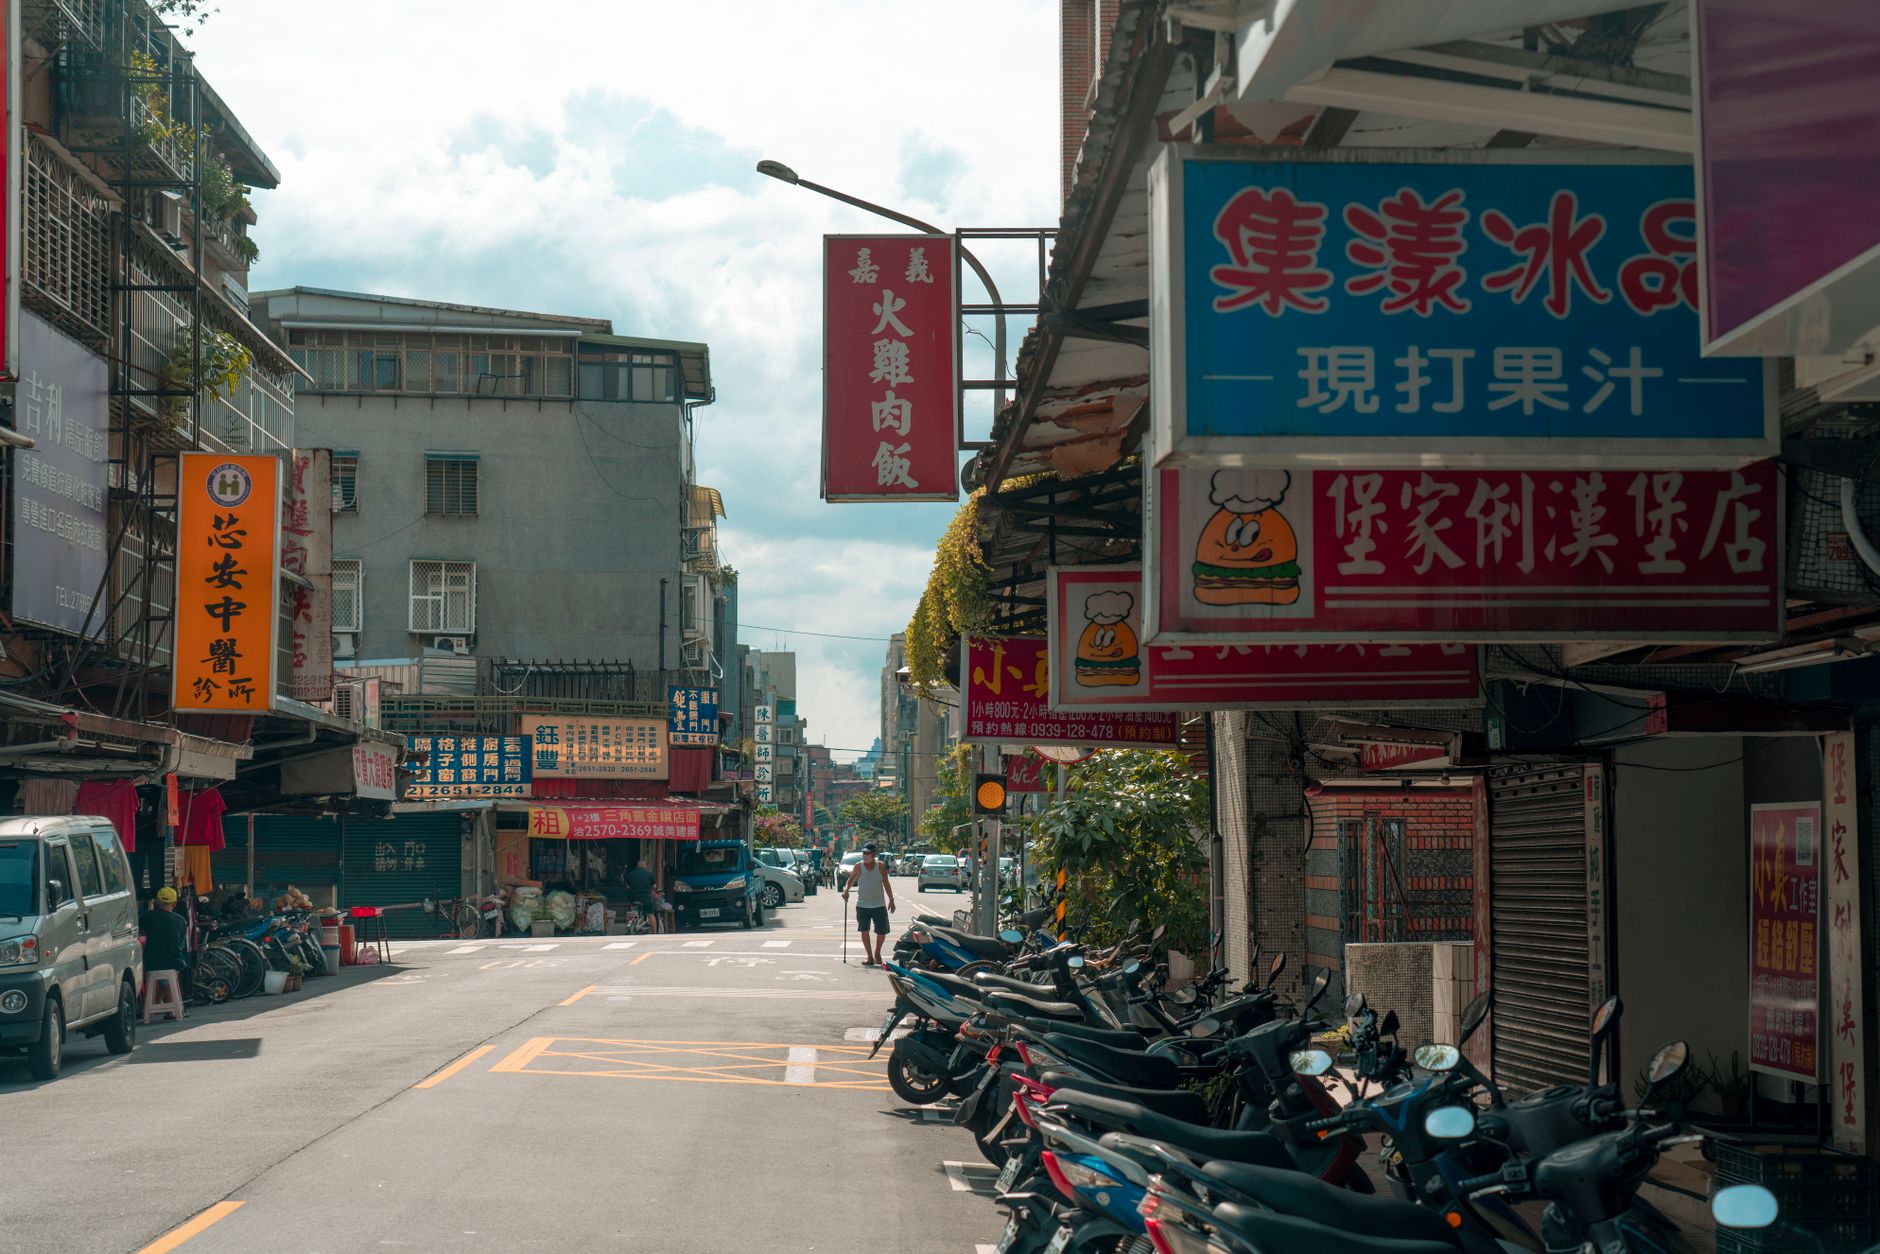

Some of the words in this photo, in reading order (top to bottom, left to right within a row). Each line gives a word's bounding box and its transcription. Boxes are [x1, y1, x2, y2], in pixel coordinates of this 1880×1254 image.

[848, 247, 934, 284] 嘉義
[1210, 185, 1699, 318] 集漾冰品
[25, 369, 62, 446] 吉利
[868, 288, 919, 489] 火雞肉飯
[1296, 345, 1663, 416] 現打果汁
[1326, 472, 1767, 576] 堡家俐漢堡店
[201, 513, 249, 677] 芯安中醫
[193, 677, 256, 704] 診所
[756, 708, 770, 801] 陳醫師診所
[534, 811, 561, 835] 租
[1789, 875, 1816, 914] 工作室
[1830, 742, 1857, 1153] 堡家俐漢堡
